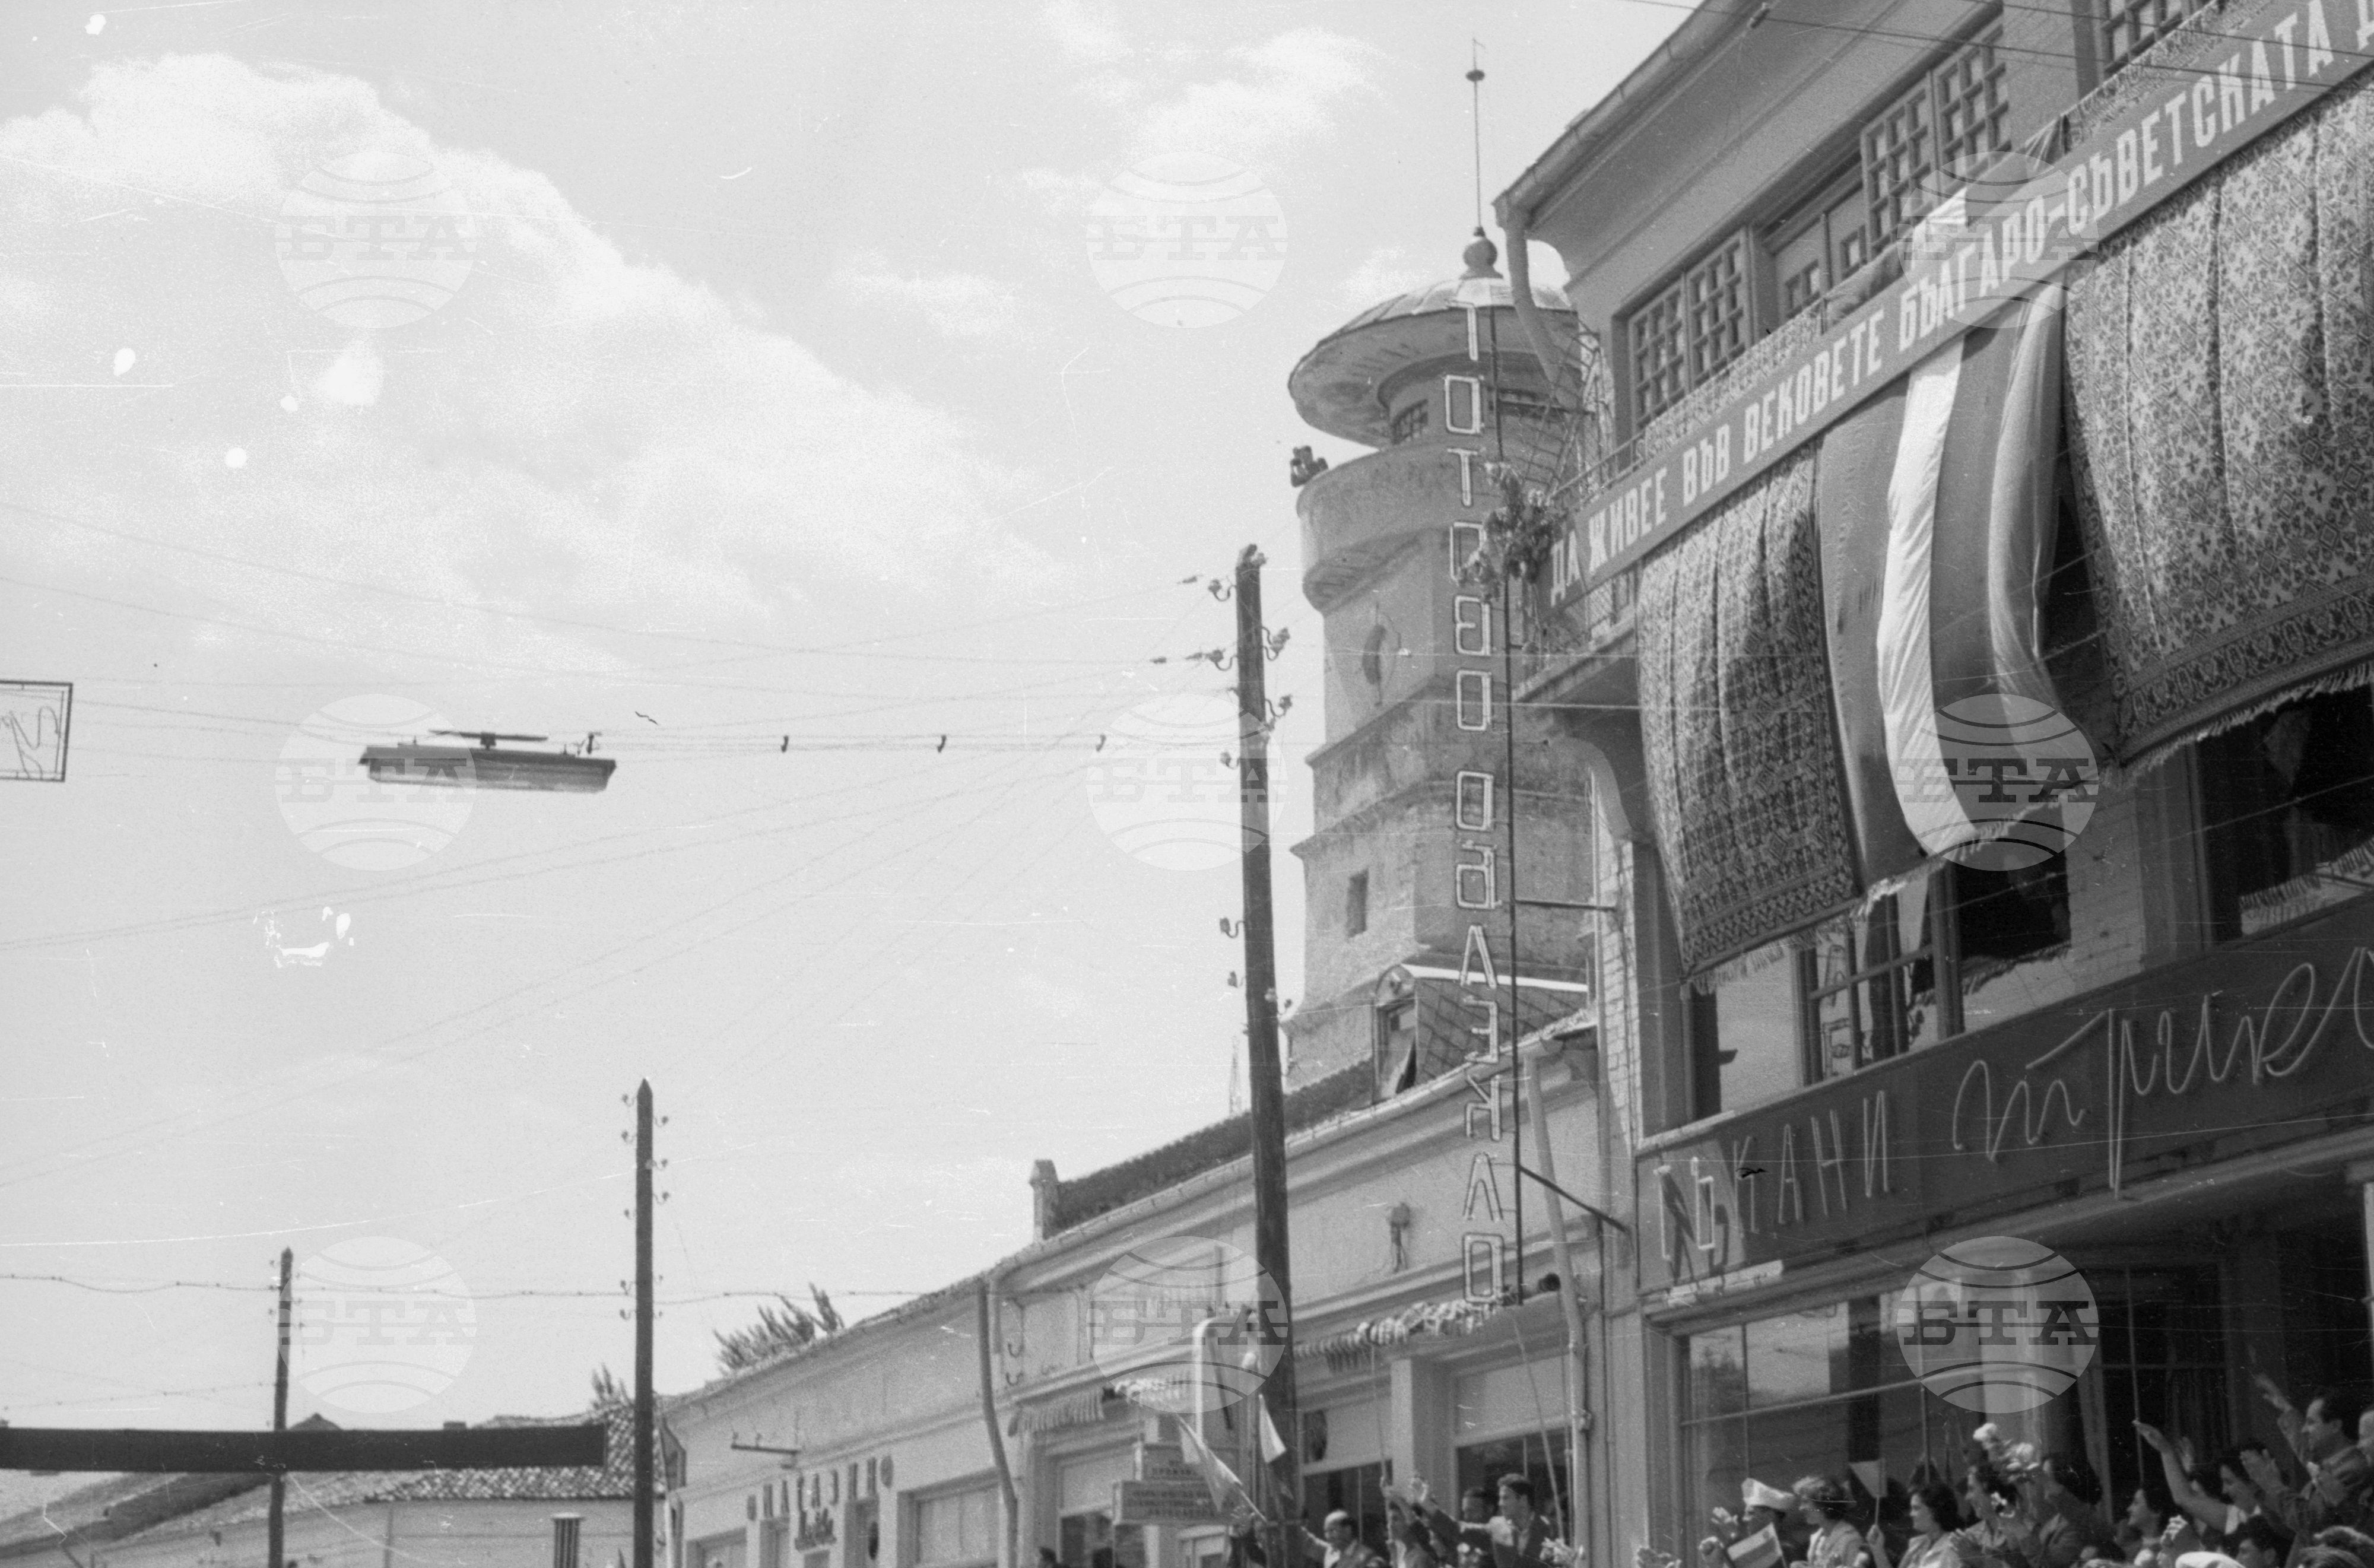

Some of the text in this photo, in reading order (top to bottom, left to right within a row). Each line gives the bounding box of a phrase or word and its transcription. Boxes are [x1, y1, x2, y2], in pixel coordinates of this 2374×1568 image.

[1550, 530, 1580, 607] ДА
[1589, 467, 1667, 575] ЖИВЕЕ
[1683, 423, 1729, 506] ВЪВ
[1744, 309, 1884, 464] ВЕКОВЕТЕ
[1899, 0, 2334, 352] БЪЛГАРО-СЪВЕТСКАТА
[1653, 1090, 1889, 1261] ТЪКАНИ
